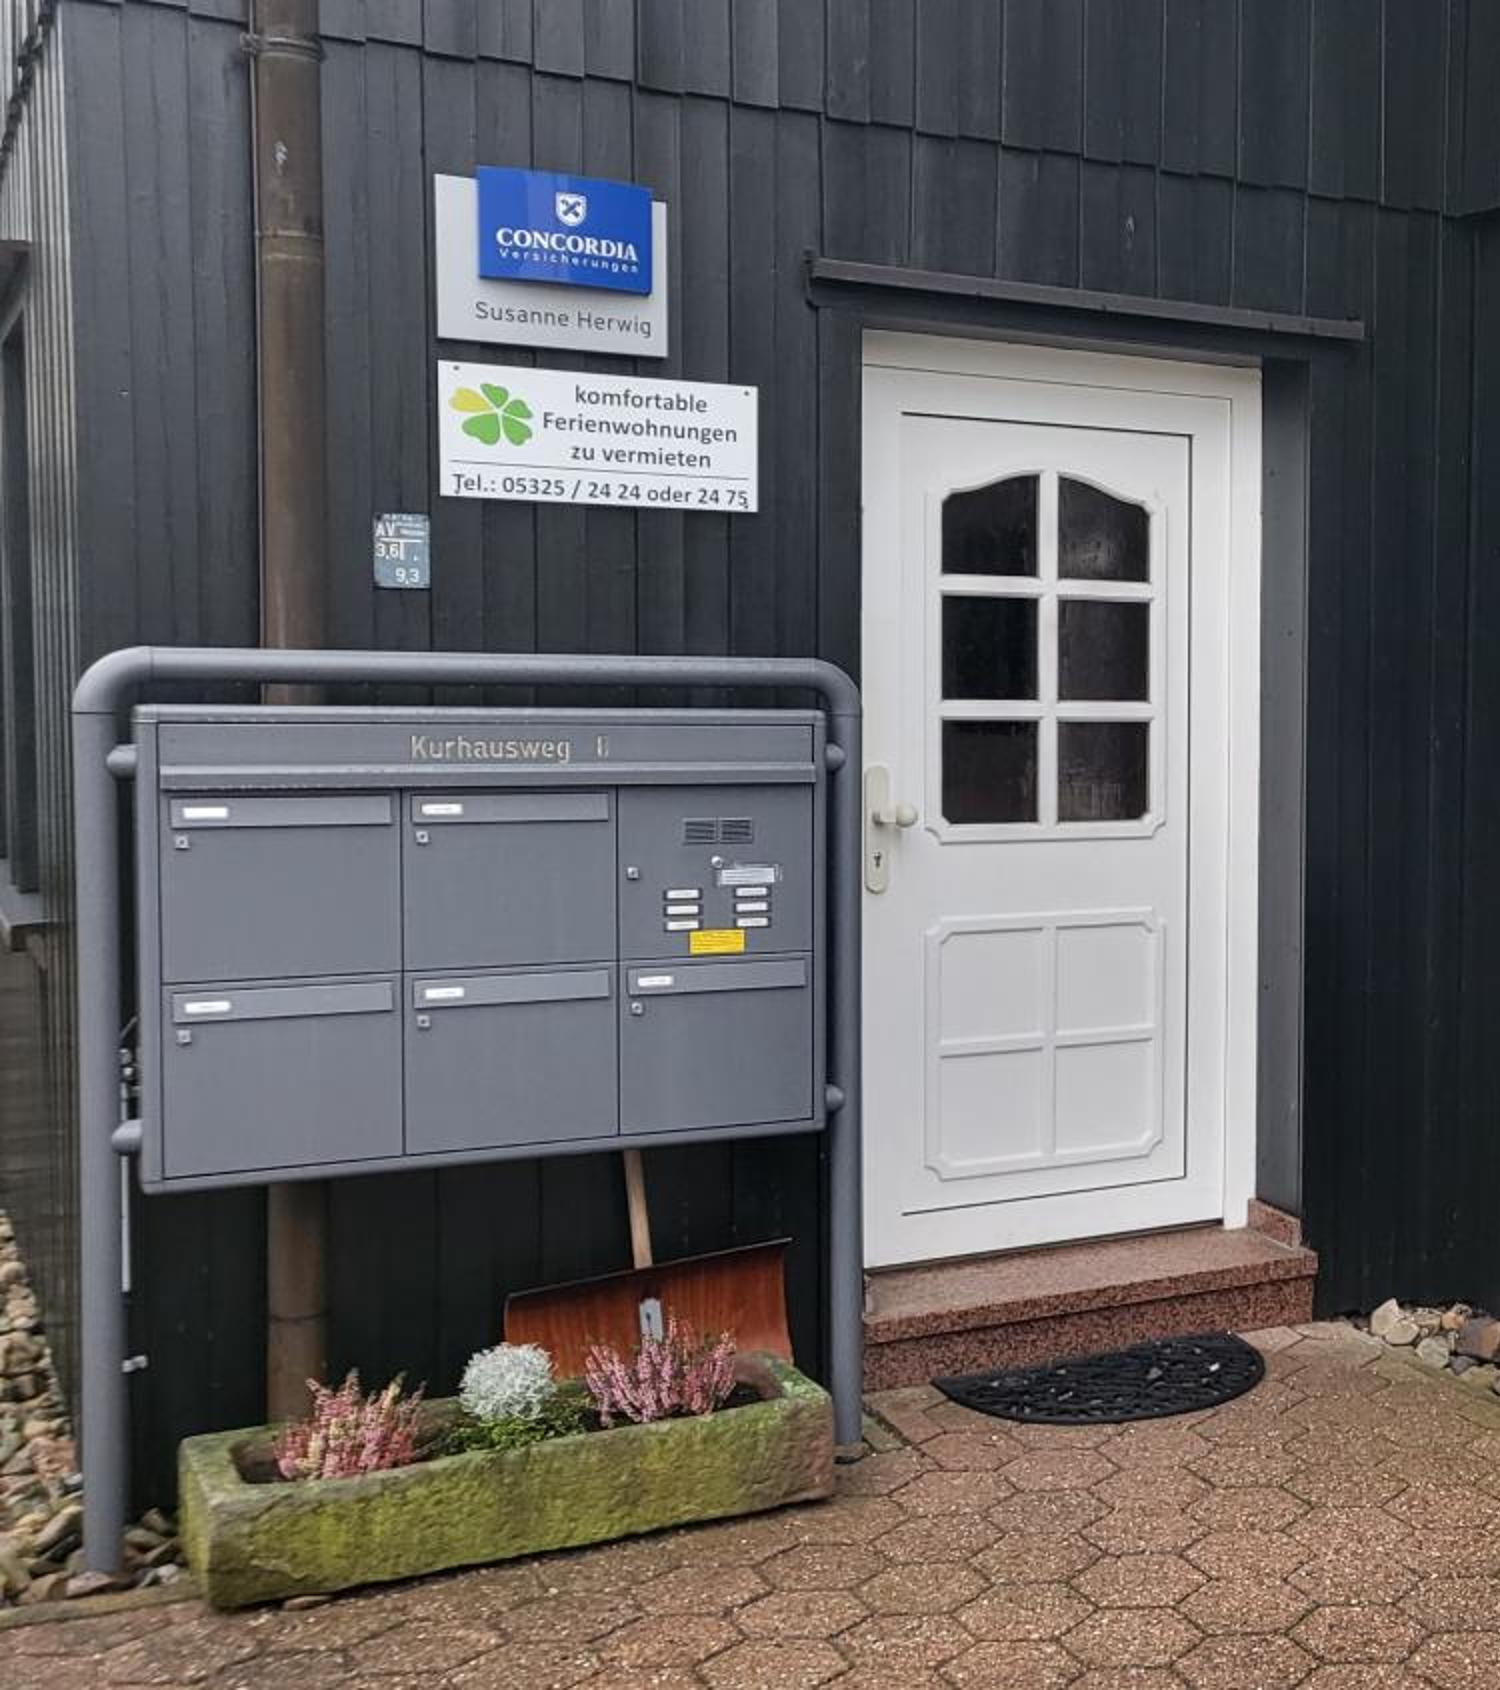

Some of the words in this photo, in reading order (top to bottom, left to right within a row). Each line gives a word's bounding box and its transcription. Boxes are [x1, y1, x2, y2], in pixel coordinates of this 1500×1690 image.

[496, 227, 639, 262] CONCORDIA
[500, 247, 638, 273] Versicherungen
[475, 301, 569, 327] Susanne
[577, 311, 651, 338] Herwig
[575, 385, 708, 413] komfortable
[543, 412, 738, 445] Ferienwohnungen
[571, 446, 595, 462] zu
[602, 447, 712, 469] vermieten
[452, 473, 496, 492] Tel.:
[502, 477, 565, 496] 05325
[571, 479, 581, 500] /
[588, 481, 611, 499] 24
[618, 483, 641, 501] 24
[647, 485, 693, 503] oder
[698, 487, 720, 505] 24
[725, 489, 749, 506] 75
[410, 735, 570, 764] Kurhausweg
